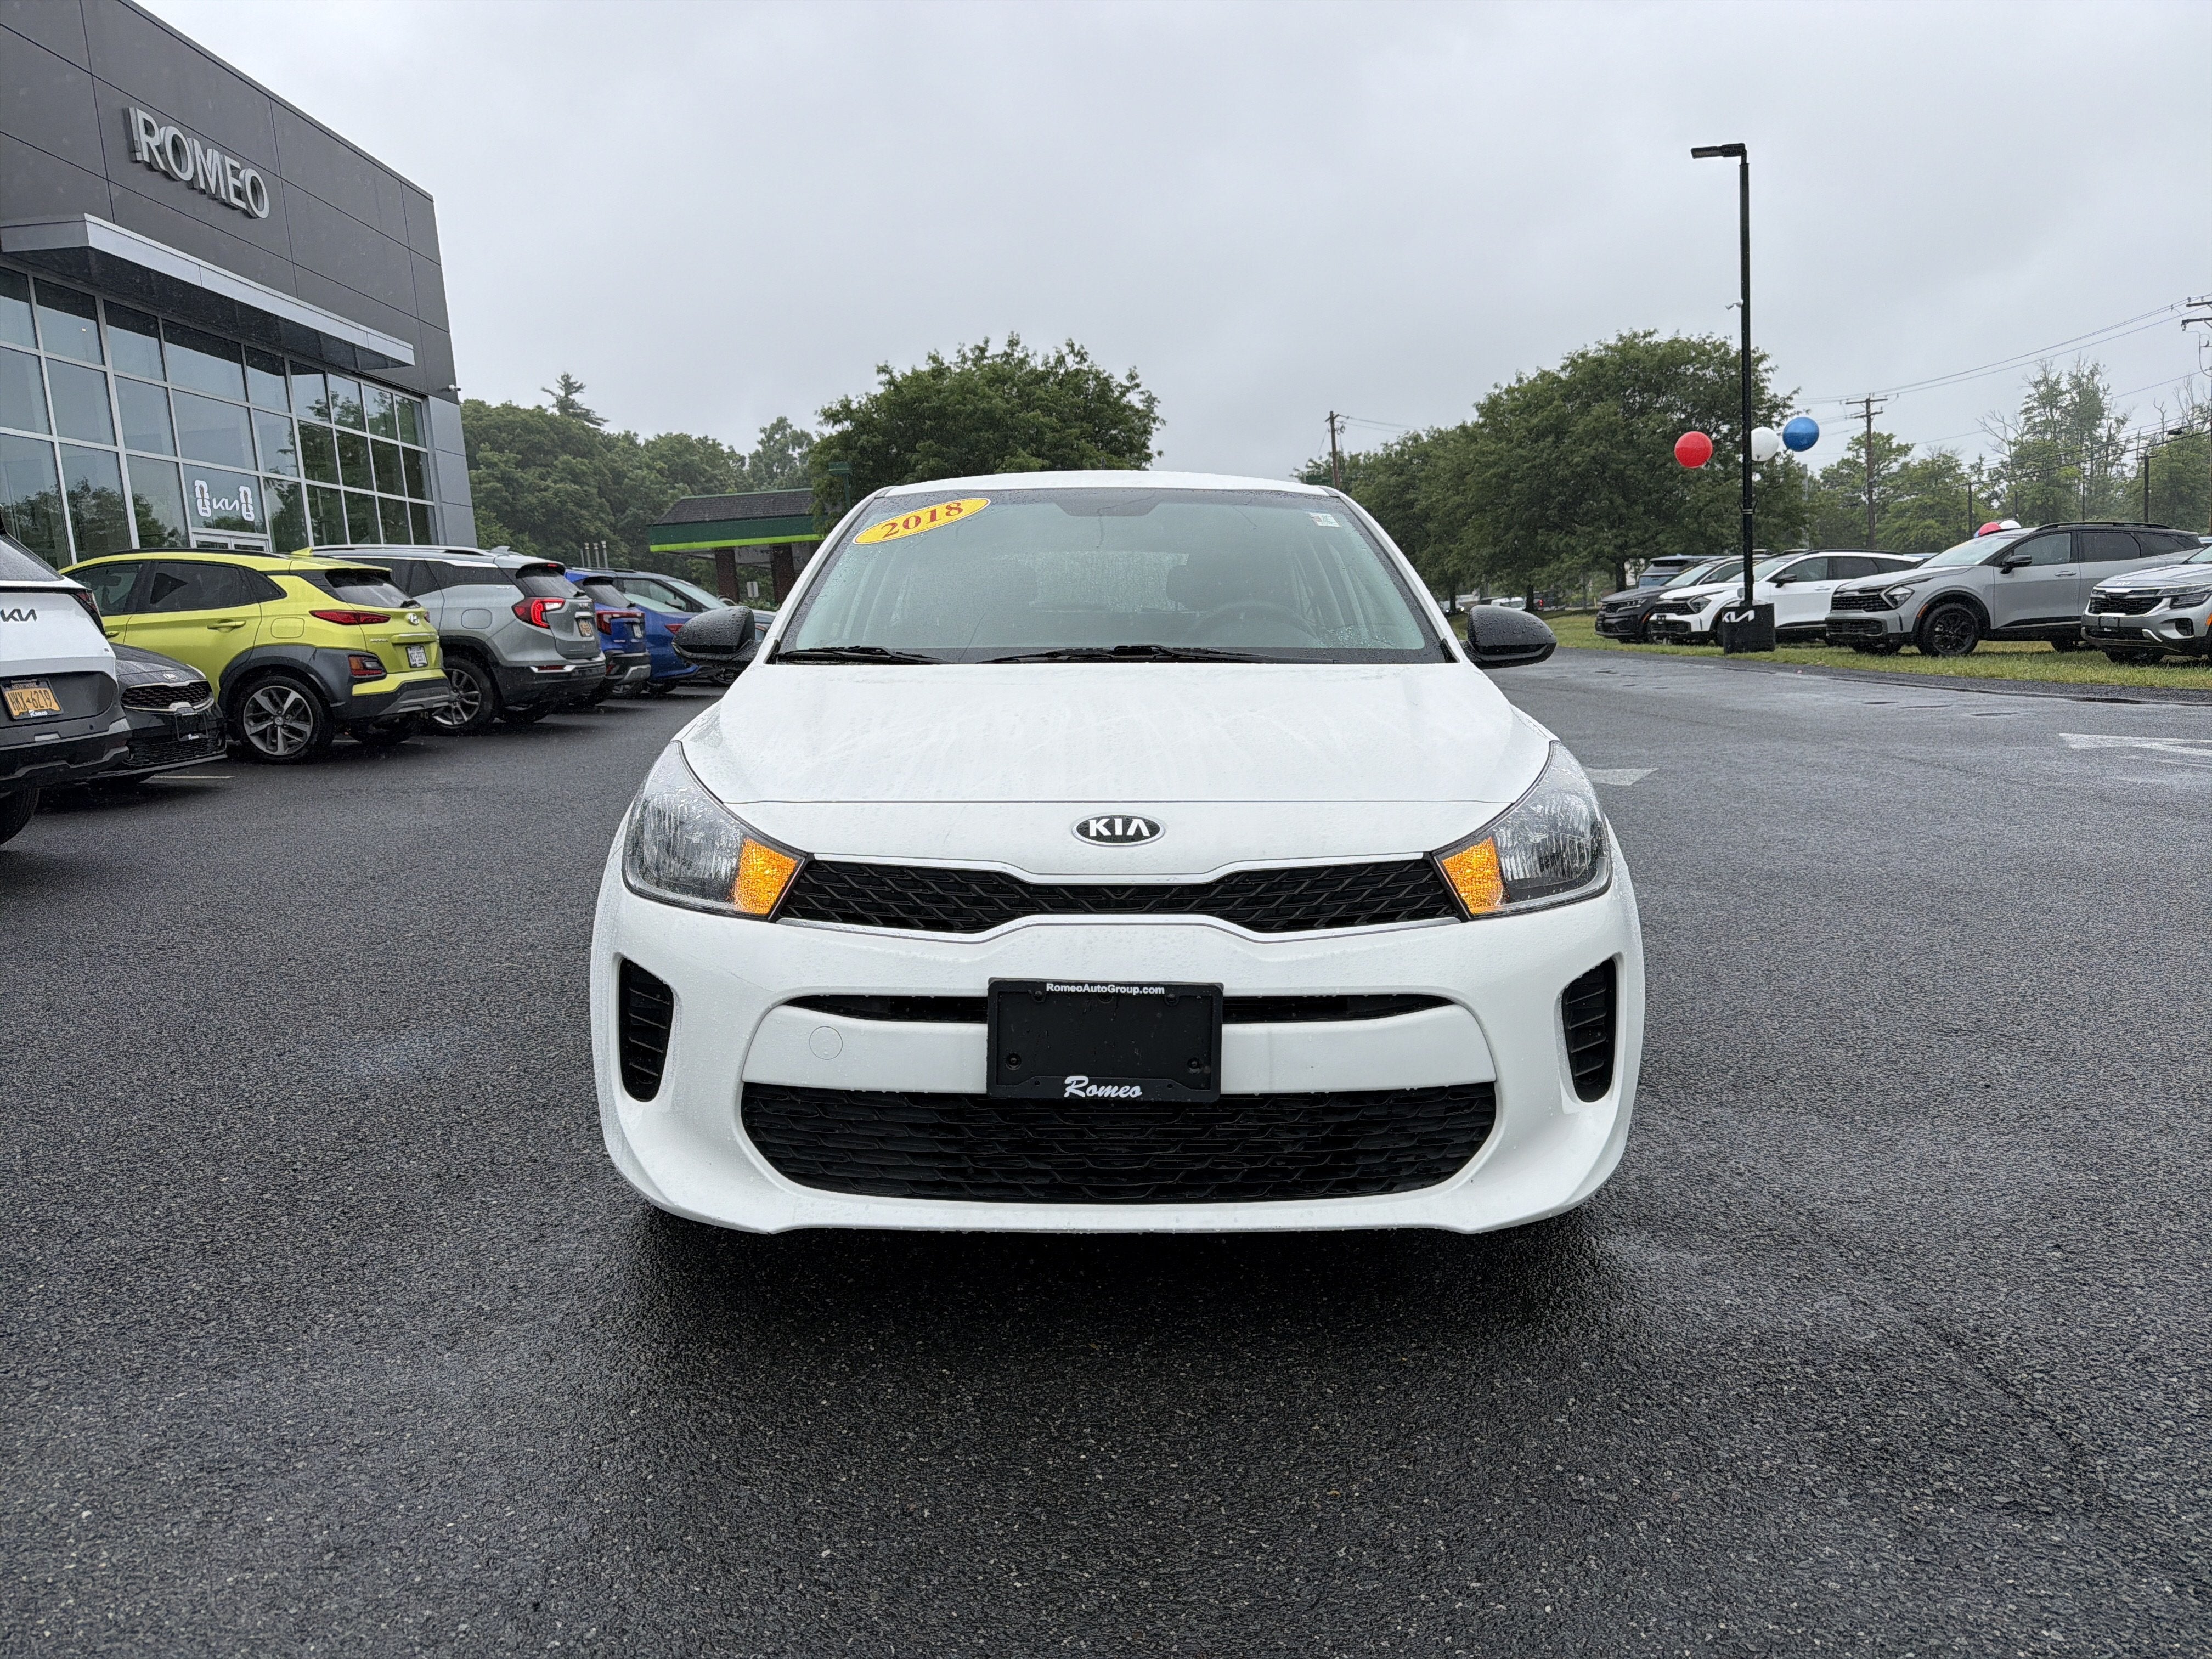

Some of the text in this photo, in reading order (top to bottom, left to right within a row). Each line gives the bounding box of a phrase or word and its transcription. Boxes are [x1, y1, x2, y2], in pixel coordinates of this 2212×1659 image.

[126, 107, 270, 218] ROMEO
[881, 502, 963, 539] 2018
[30, 689, 52, 709] 6219
[1088, 818, 1150, 837] KIA
[1046, 983, 1165, 995] RomeoAutoGroup.com
[1064, 1075, 1143, 1098] Romeo
